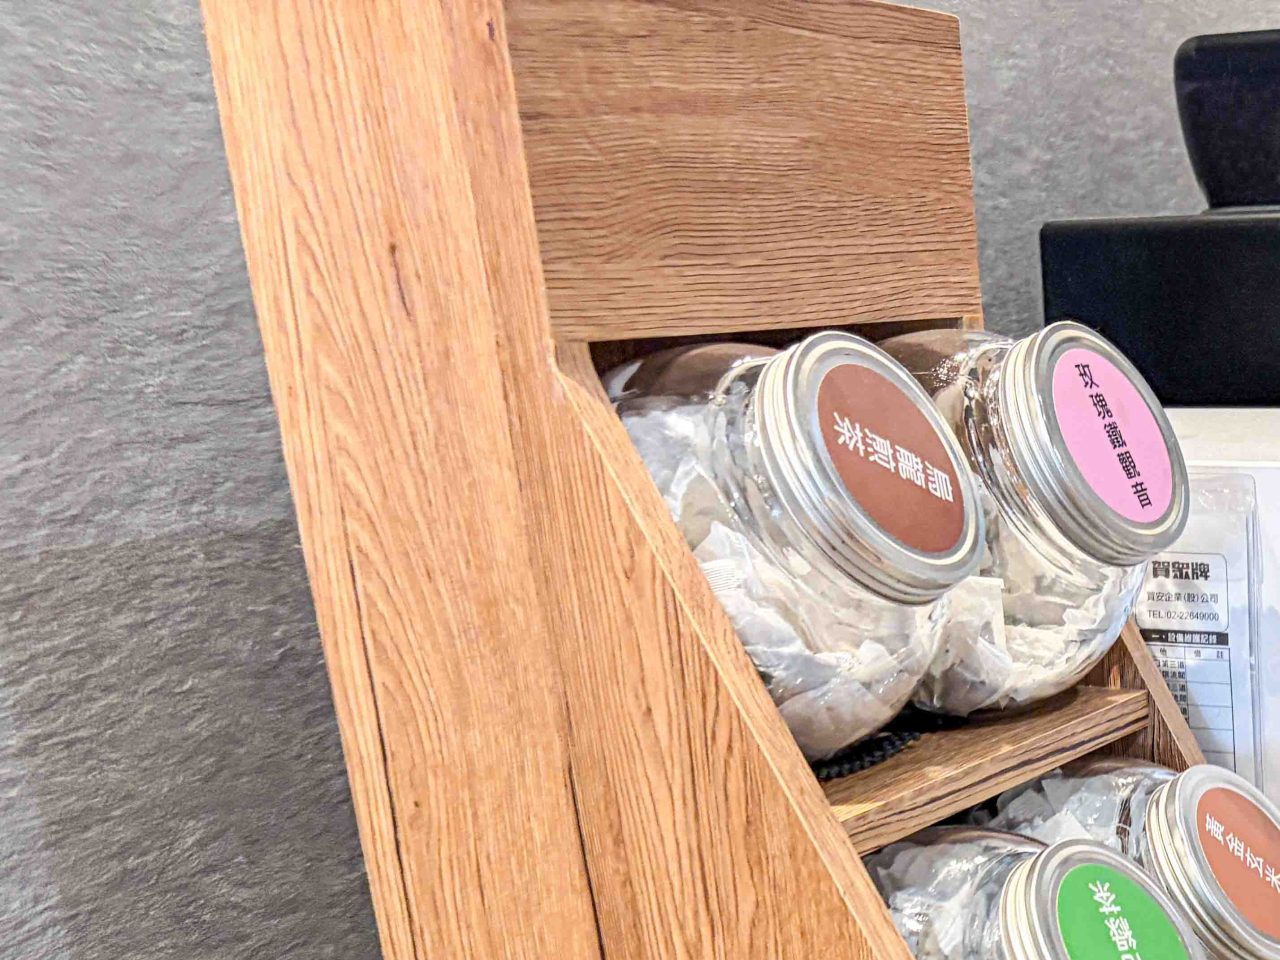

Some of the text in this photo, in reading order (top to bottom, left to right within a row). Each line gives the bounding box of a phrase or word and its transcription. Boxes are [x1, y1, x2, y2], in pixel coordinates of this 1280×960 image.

[832, 411, 955, 503] 烏龍煎茶
[1075, 363, 1152, 509] 玫瑰鐵觀音
